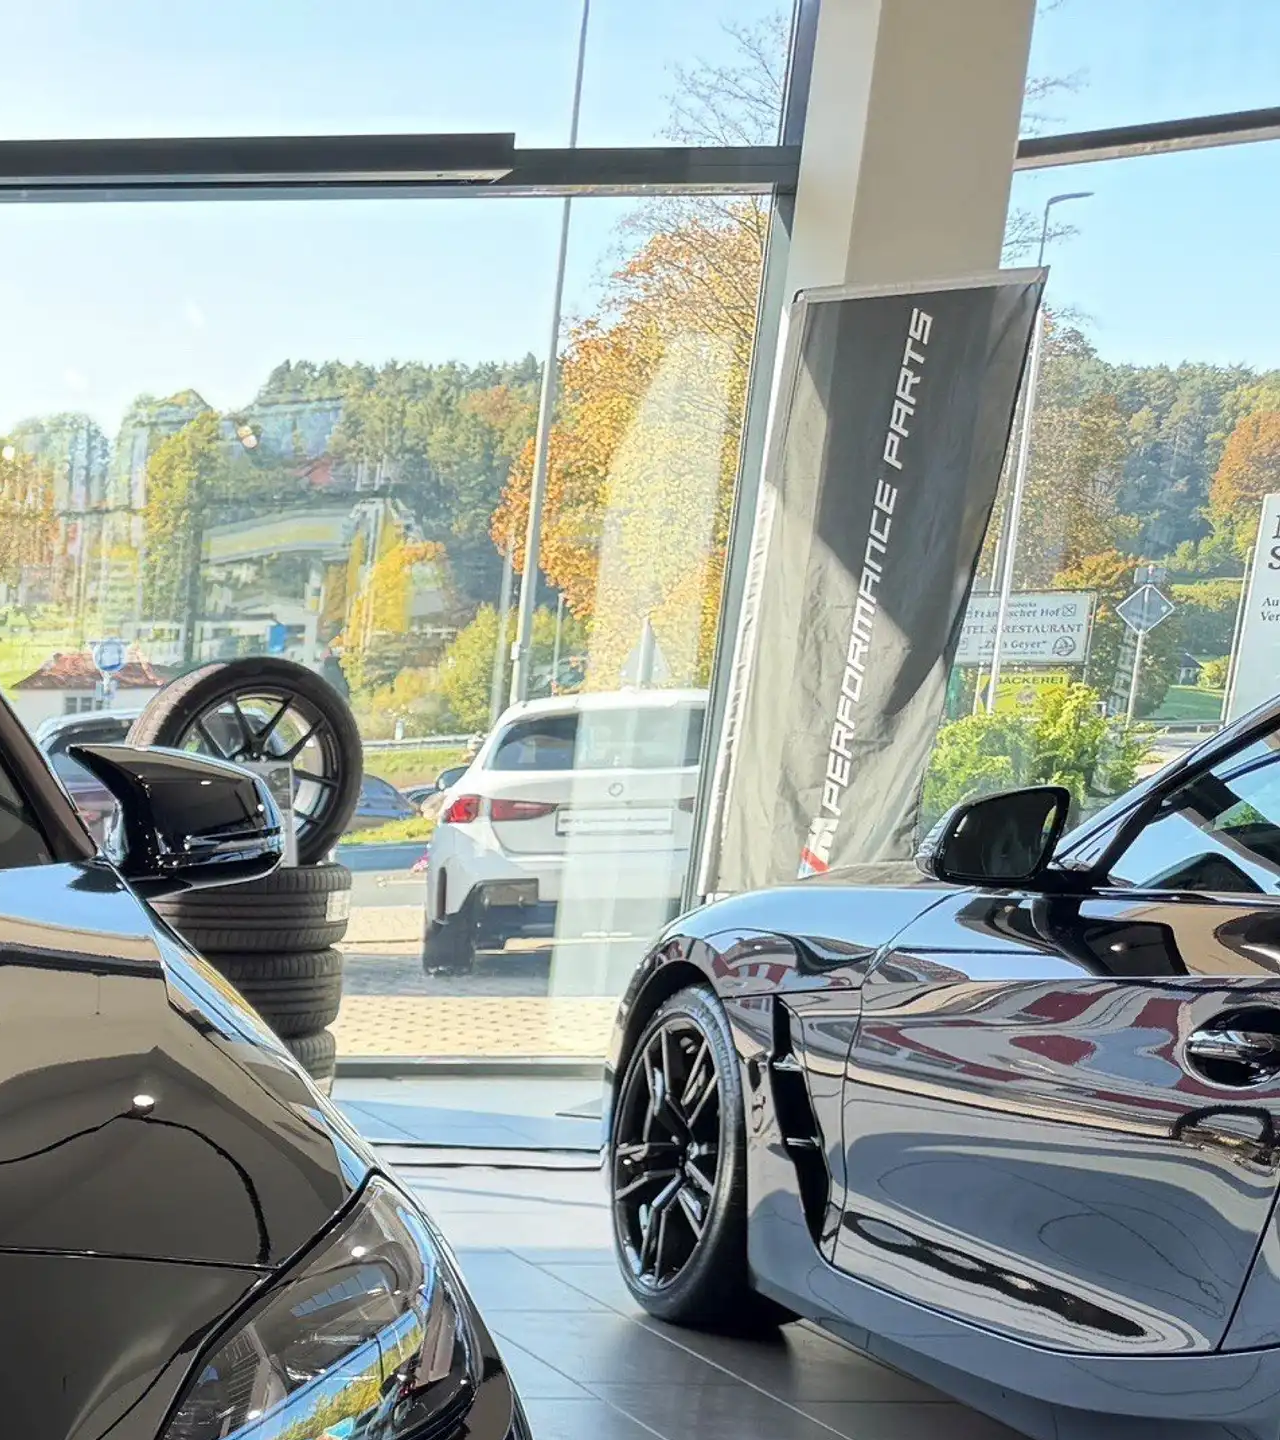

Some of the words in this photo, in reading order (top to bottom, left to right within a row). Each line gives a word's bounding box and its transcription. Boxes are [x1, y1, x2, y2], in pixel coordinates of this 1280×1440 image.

[821, 478, 898, 816] PERFORMANCE
[883, 308, 933, 470] PARTS
[1040, 607, 1061, 618] Hof
[1002, 624, 1082, 634] RESTAURANT
